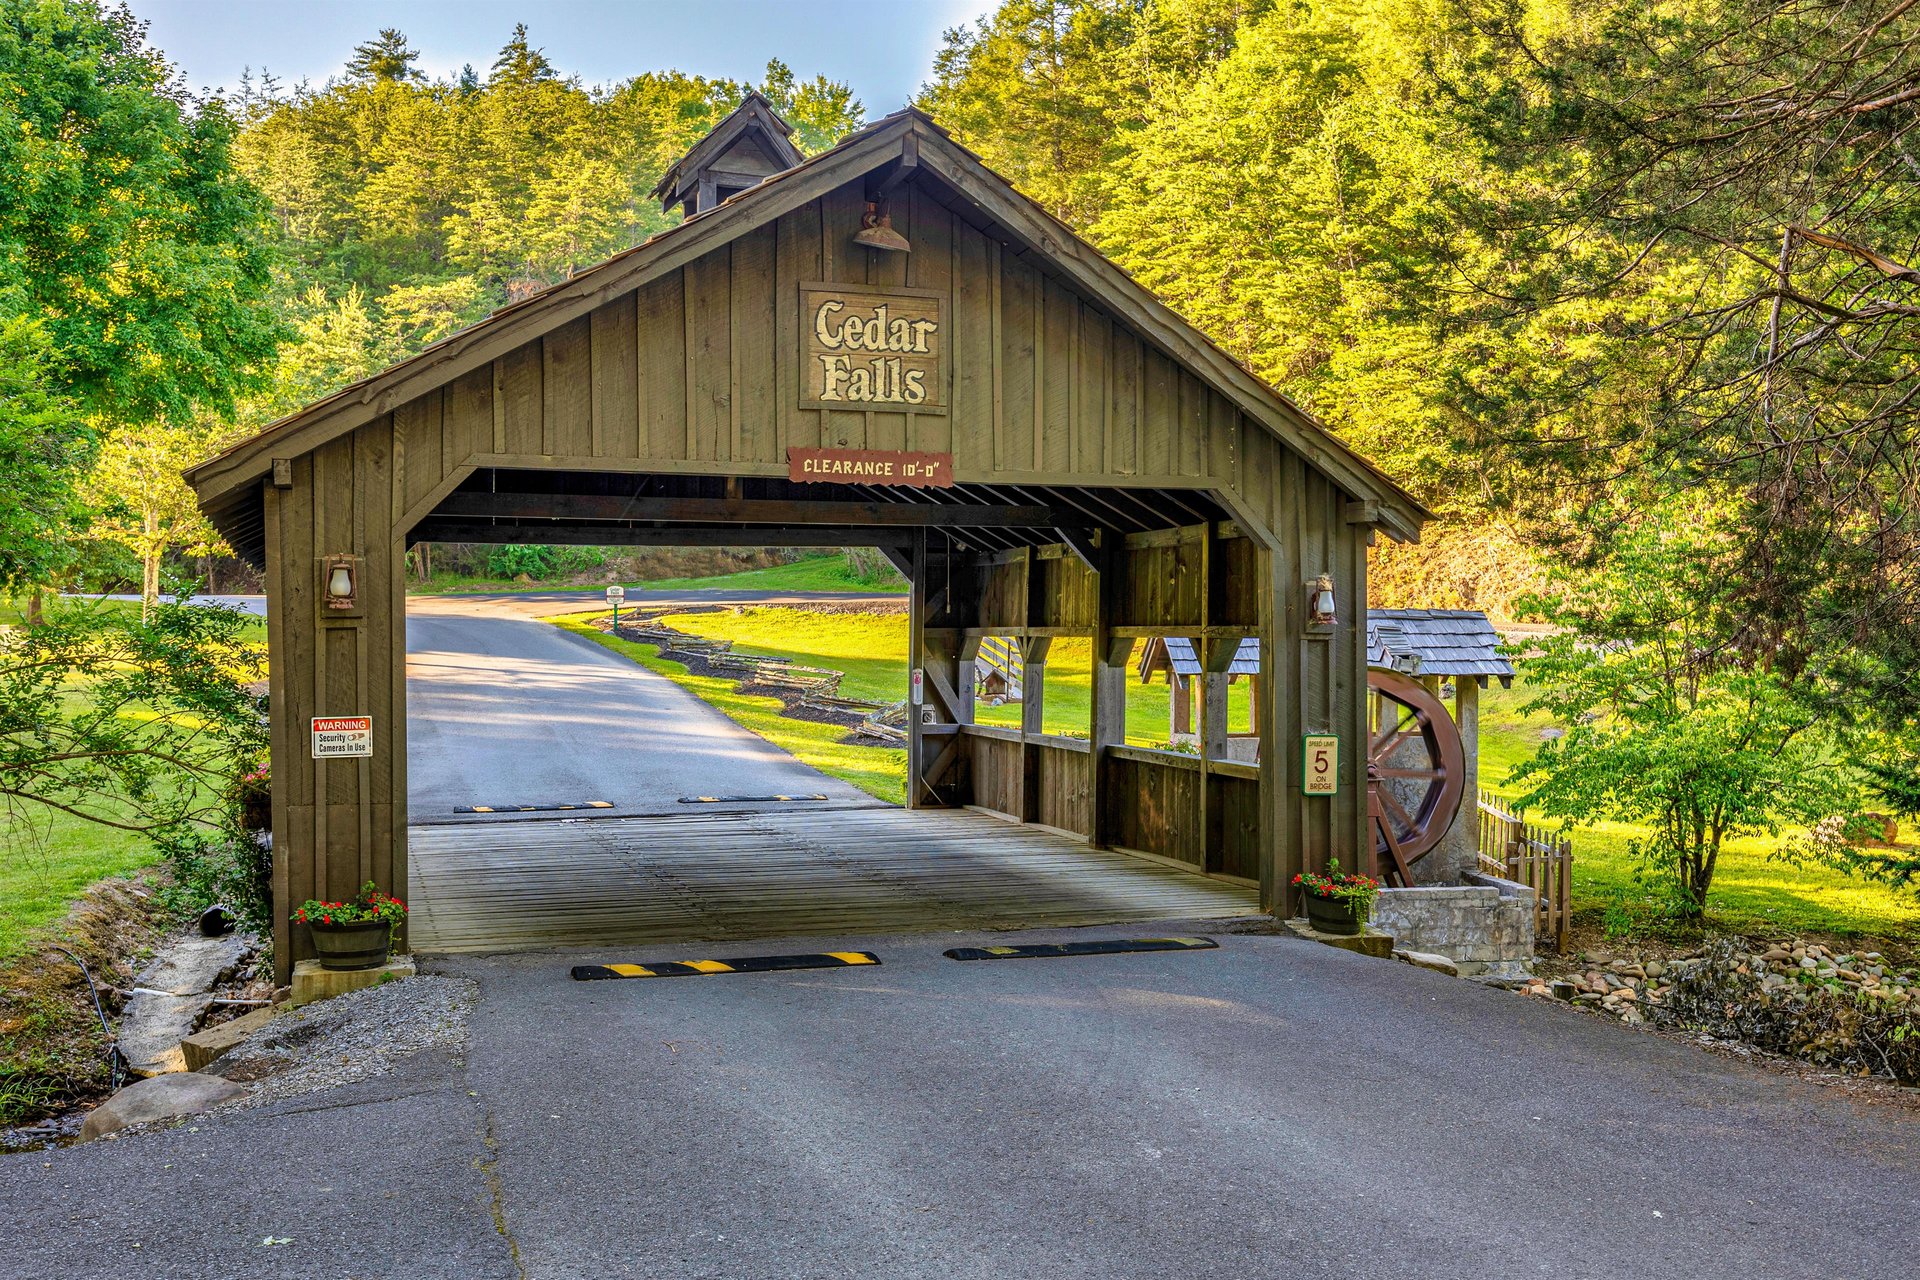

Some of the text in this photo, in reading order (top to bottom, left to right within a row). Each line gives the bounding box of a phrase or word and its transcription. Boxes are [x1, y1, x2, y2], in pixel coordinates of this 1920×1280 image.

[816, 300, 938, 353] Cedar
[818, 355, 926, 404] Falls
[803, 459, 939, 477] CLEARANCE 10'-0"
[318, 720, 366, 730] WARNING
[319, 734, 346, 743] Security
[319, 744, 346, 752] Cameras
[355, 743, 366, 751] Use
[1314, 750, 1328, 774] 5
